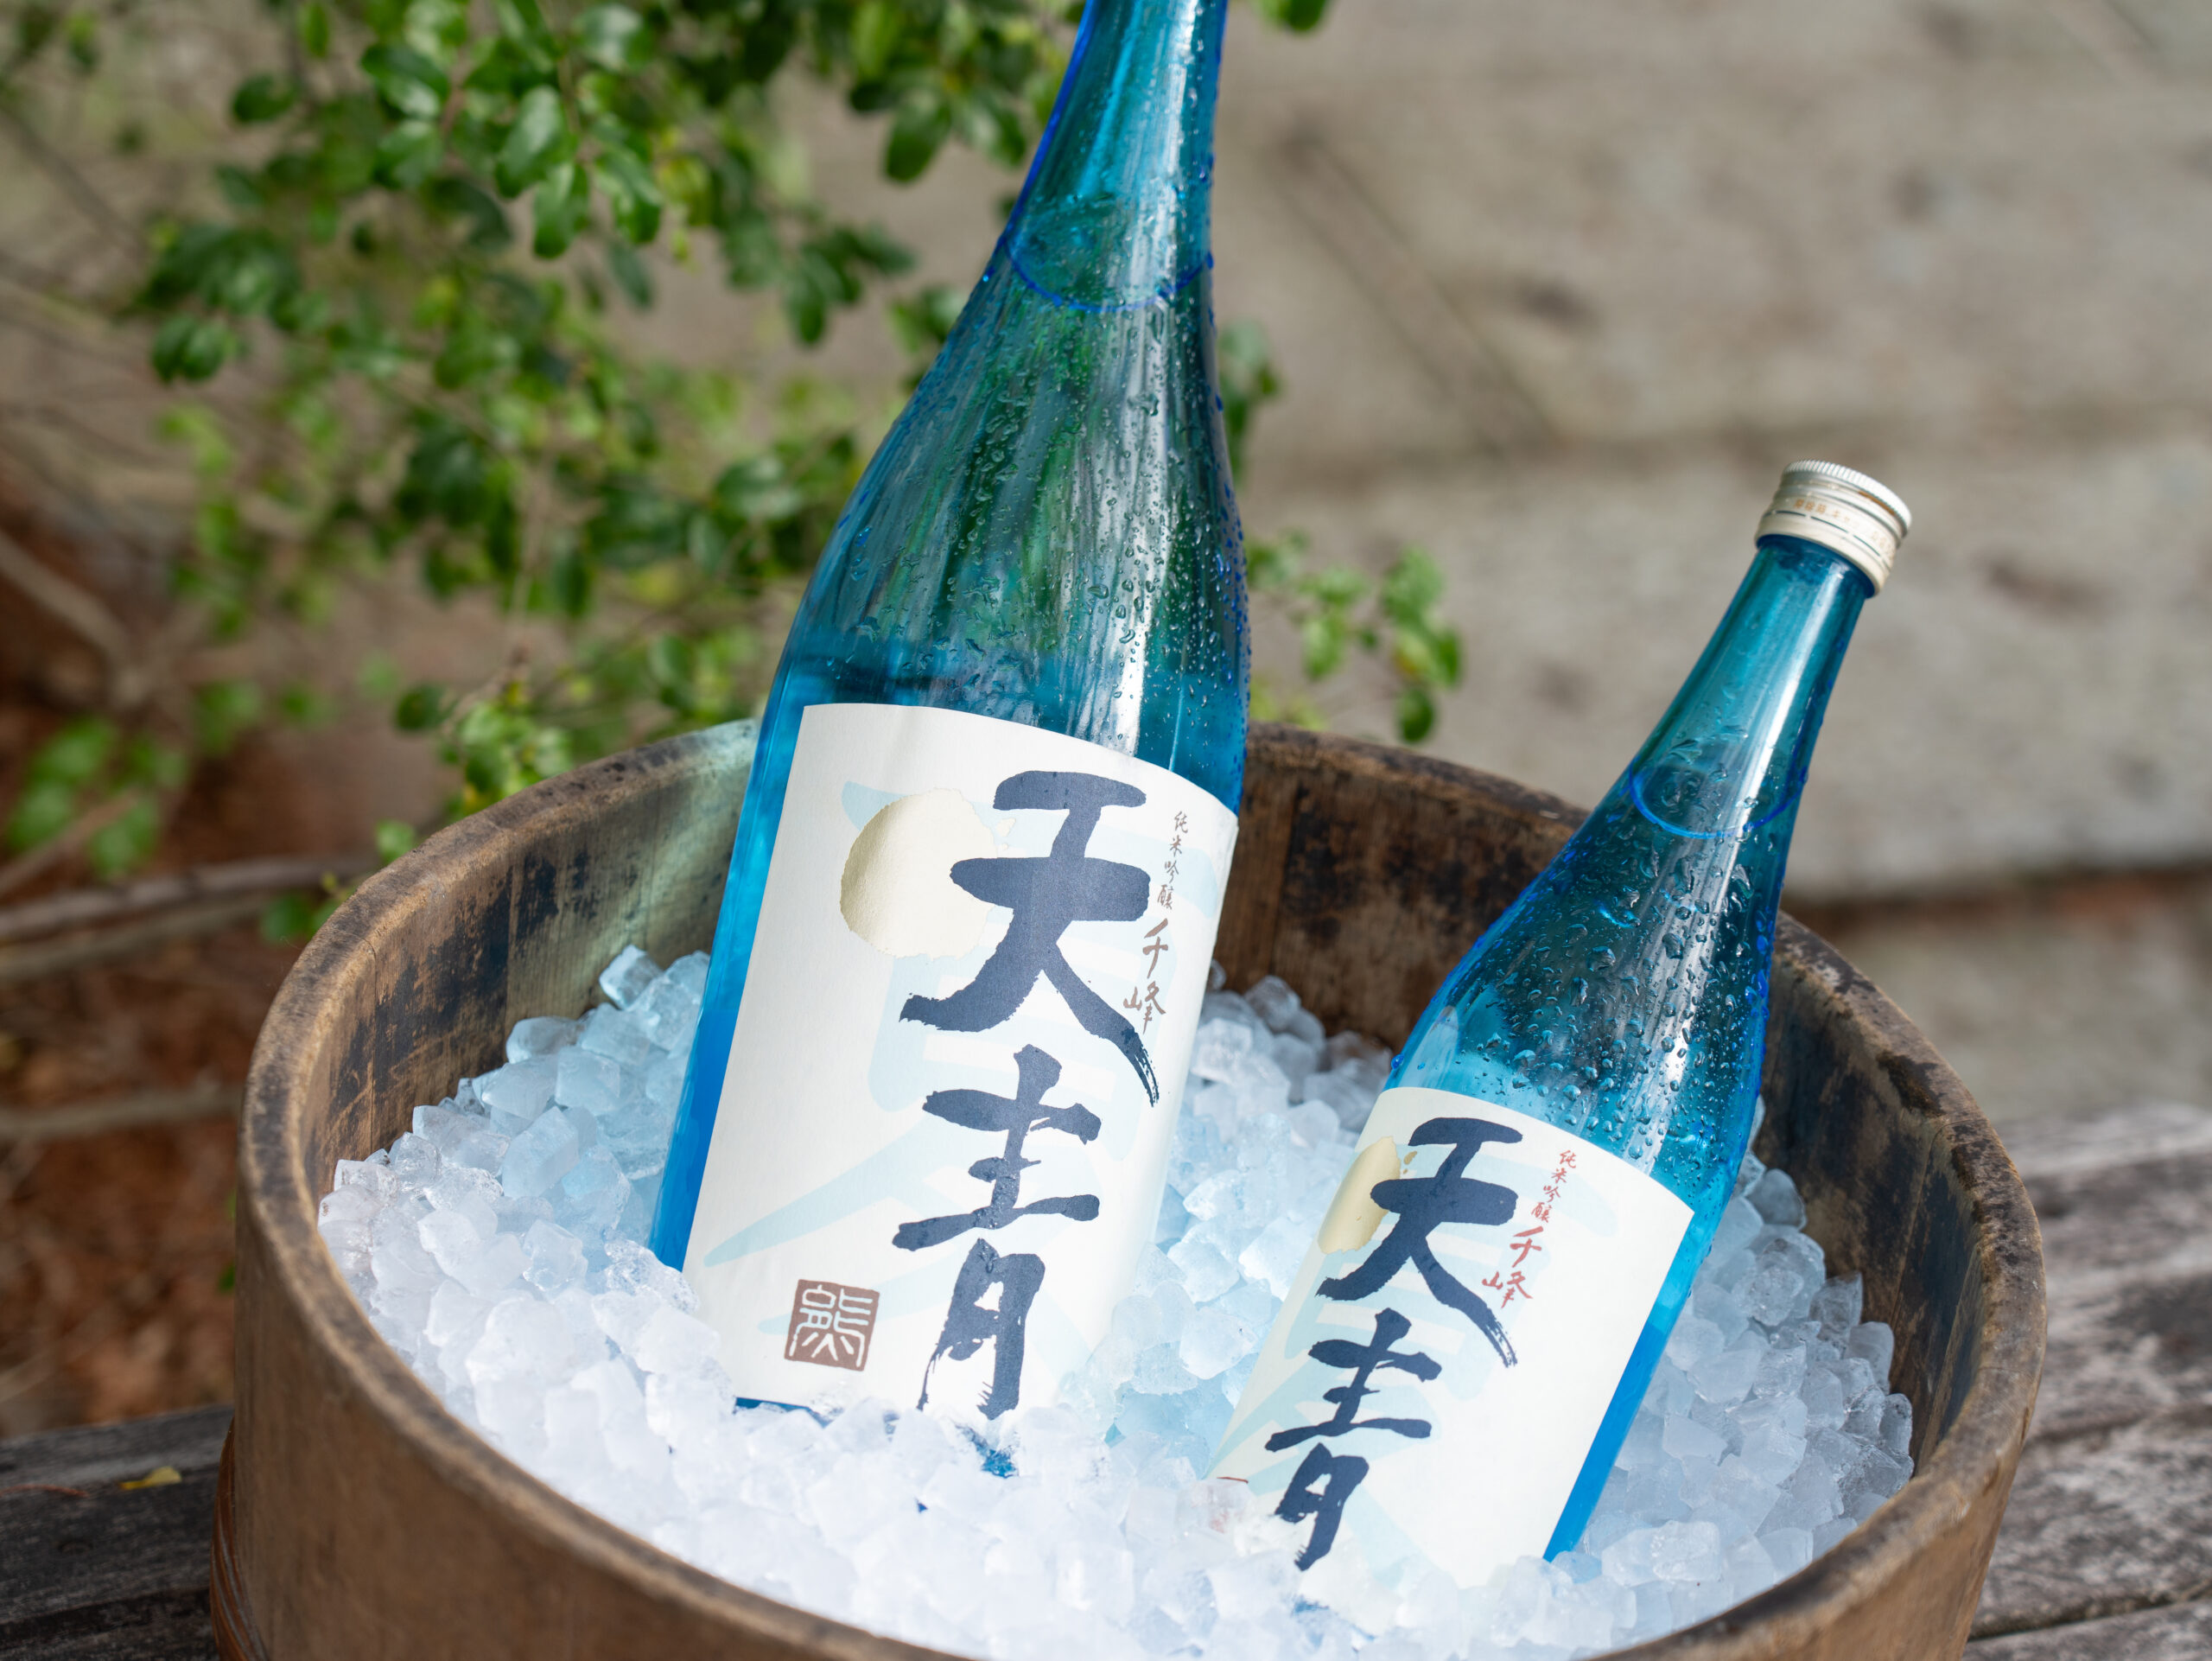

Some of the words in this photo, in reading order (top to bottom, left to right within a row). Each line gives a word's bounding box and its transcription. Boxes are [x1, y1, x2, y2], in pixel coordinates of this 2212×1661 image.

[892, 770, 1160, 1422] 天青
[1122, 918, 1169, 1035] 千峰
[1263, 1117, 1524, 1572] 天青
[1481, 1225, 1544, 1309] 千峰
